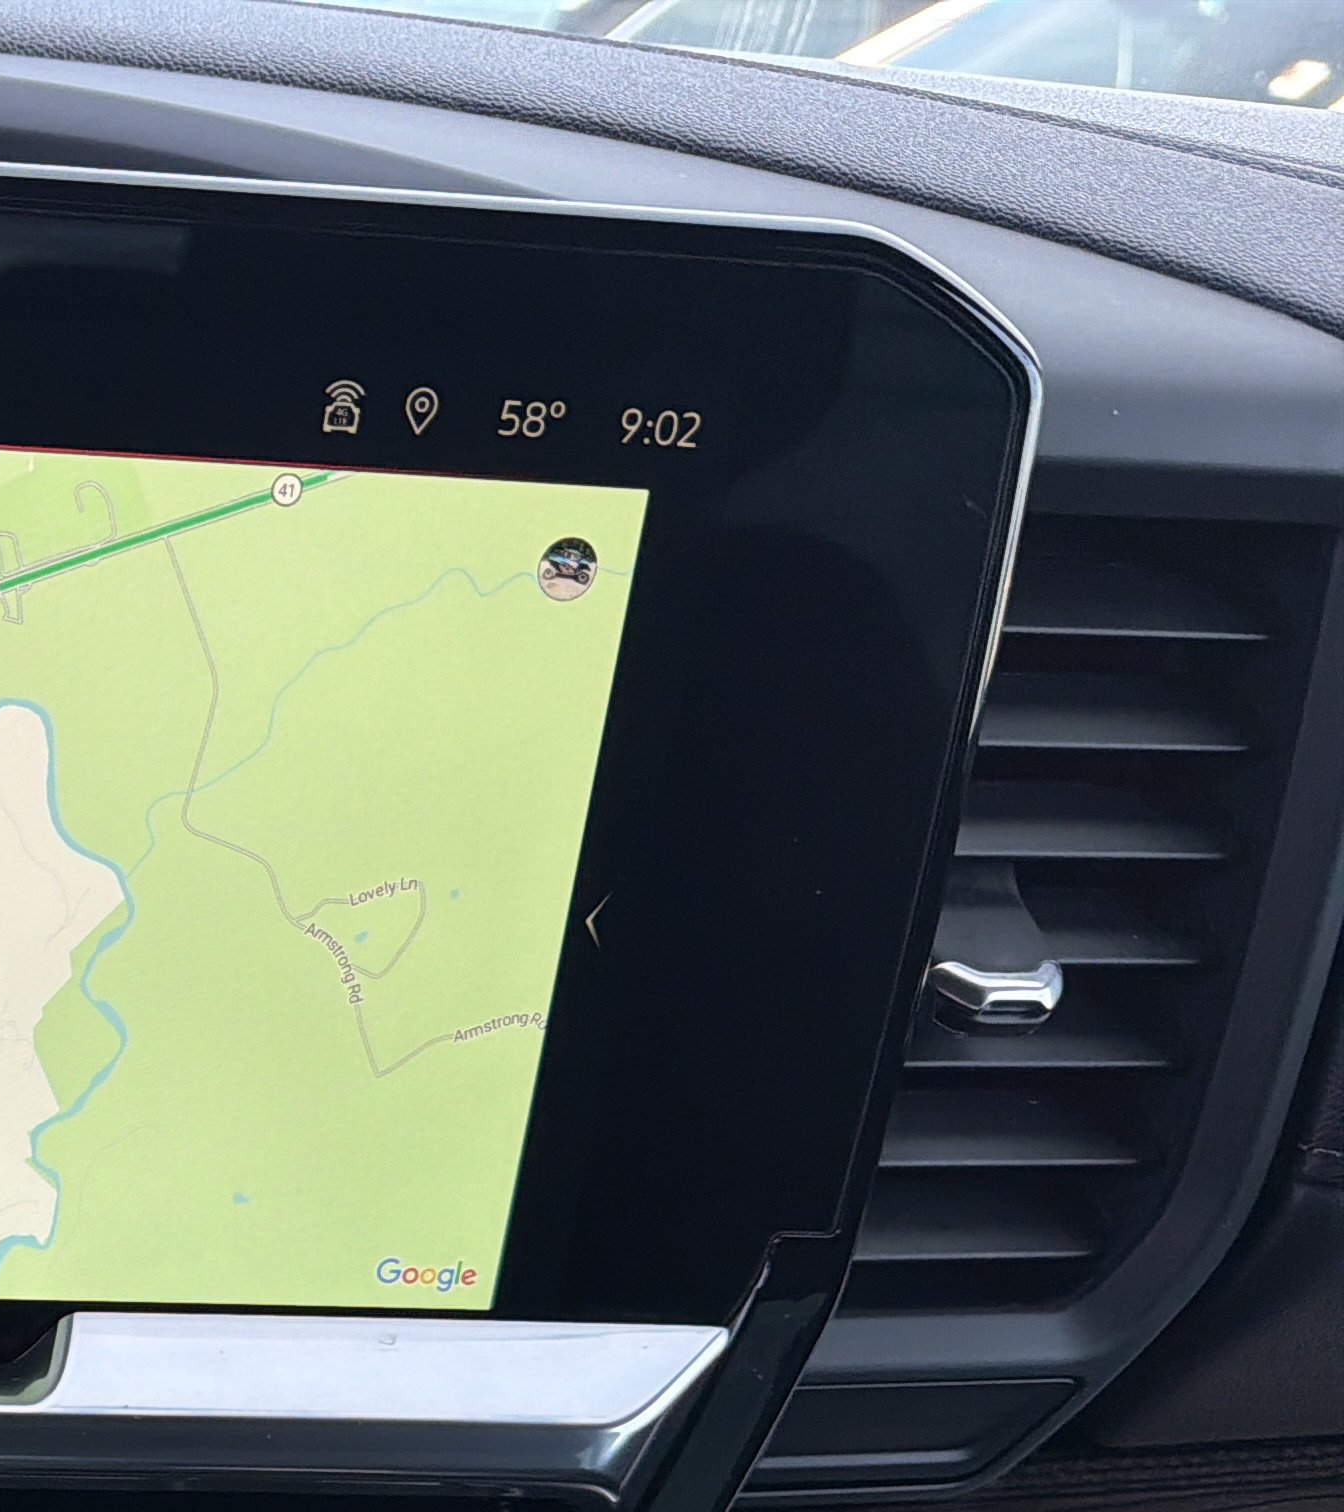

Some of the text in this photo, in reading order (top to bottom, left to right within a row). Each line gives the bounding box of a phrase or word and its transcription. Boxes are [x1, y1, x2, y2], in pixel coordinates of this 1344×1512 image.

[619, 407, 702, 449] 9:02
[278, 481, 296, 498] 41
[349, 877, 418, 907] Lovely Ln
[304, 922, 364, 1005] Armstrong Rd
[453, 1013, 529, 1043] Armstrong
[376, 1256, 478, 1292] Google
